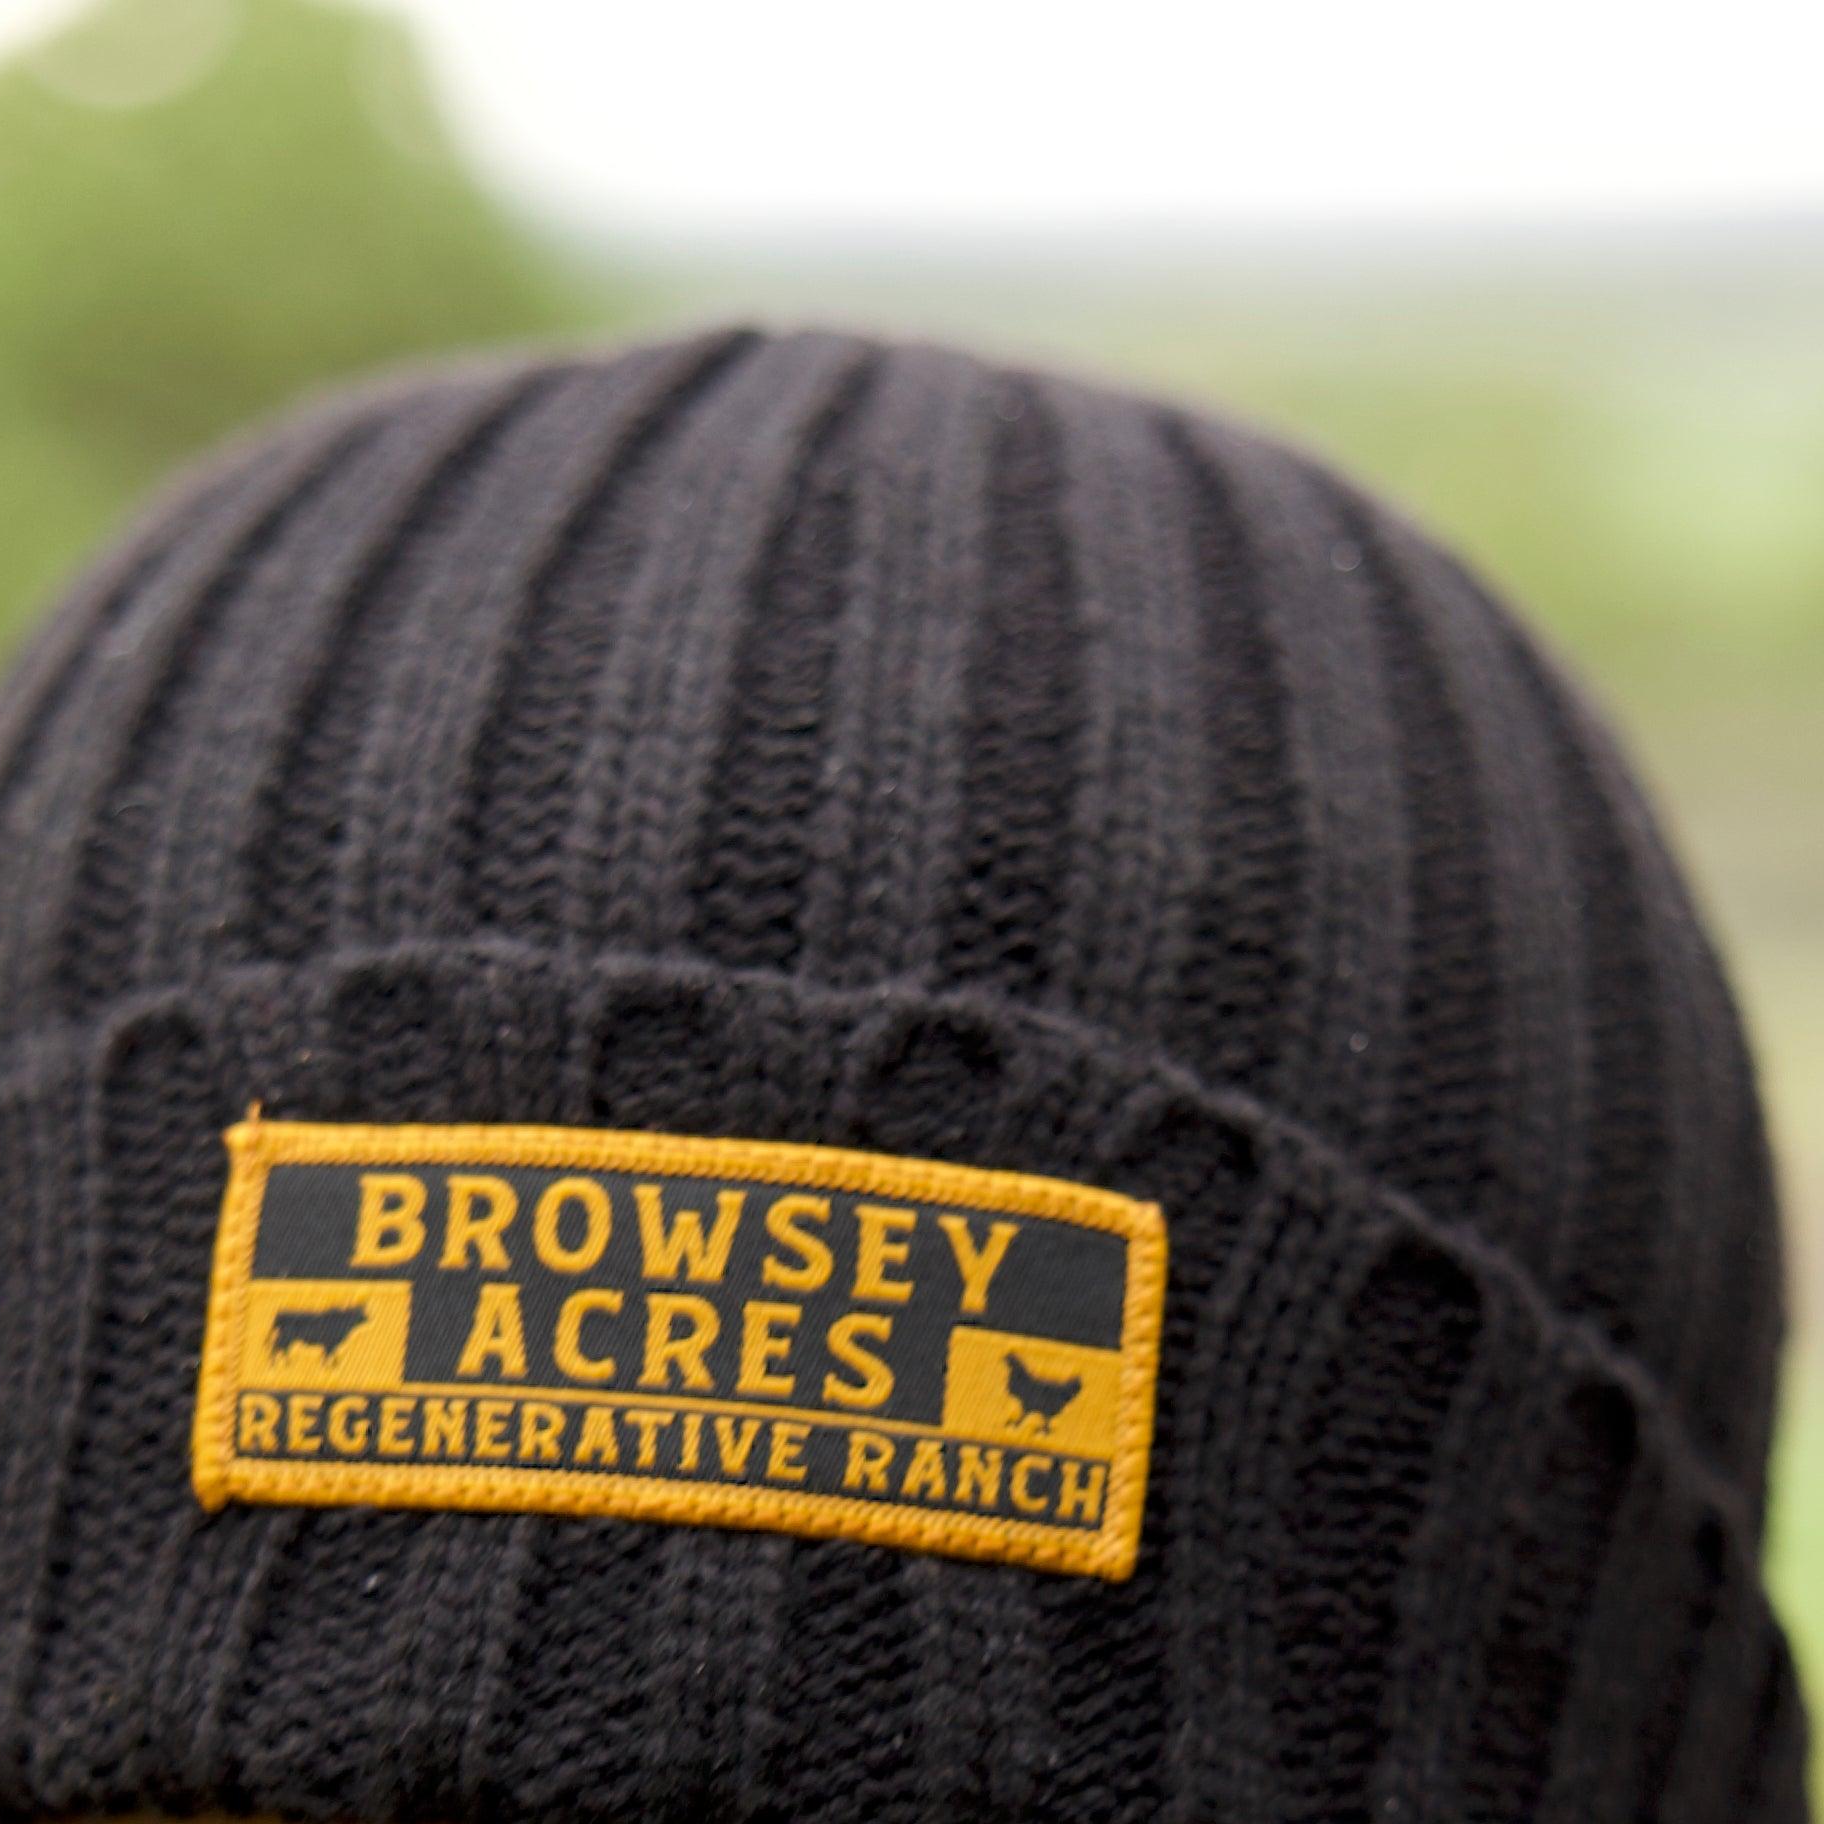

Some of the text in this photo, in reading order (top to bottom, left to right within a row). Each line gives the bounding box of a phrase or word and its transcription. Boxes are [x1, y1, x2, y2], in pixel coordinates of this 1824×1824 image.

[350, 1173, 1018, 1314] BROWSEY
[456, 1282, 896, 1408] ACRES
[238, 1394, 1108, 1522] REGENERATIVE RANCH
